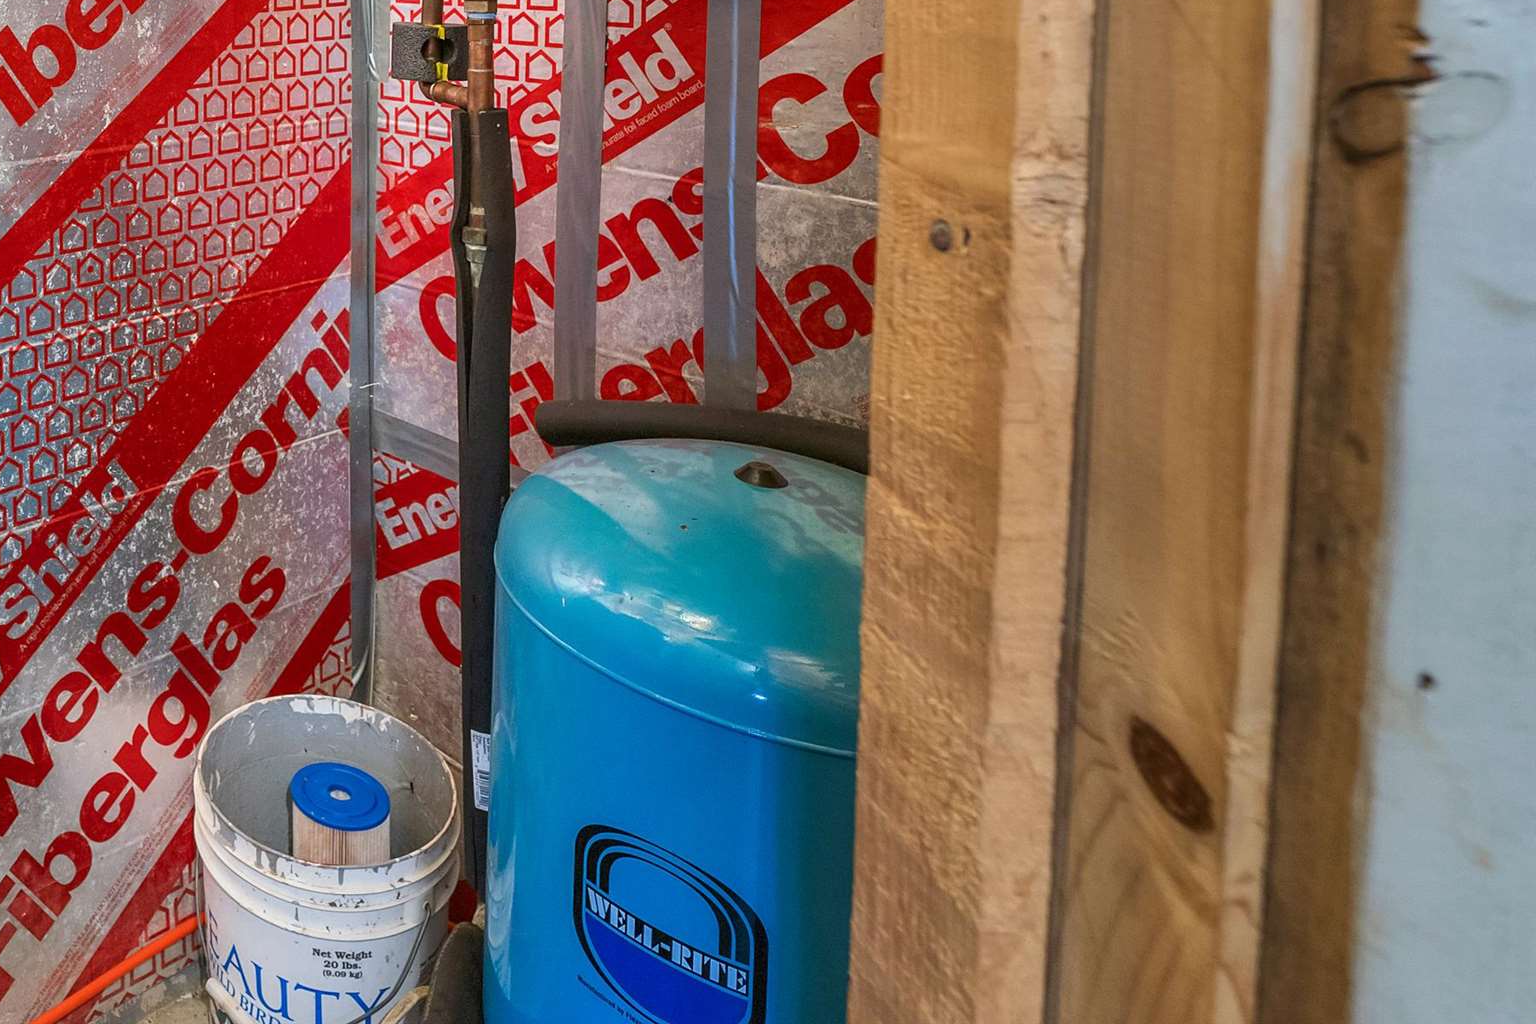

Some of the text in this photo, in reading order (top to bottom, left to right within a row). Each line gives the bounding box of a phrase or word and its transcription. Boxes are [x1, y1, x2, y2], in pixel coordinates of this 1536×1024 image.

[586, 886, 749, 995] WELL-RITE
[312, 948, 373, 962] Net Weight
[323, 960, 362, 970] 20 lbs.
[322, 969, 364, 979] (9.09 kg)
